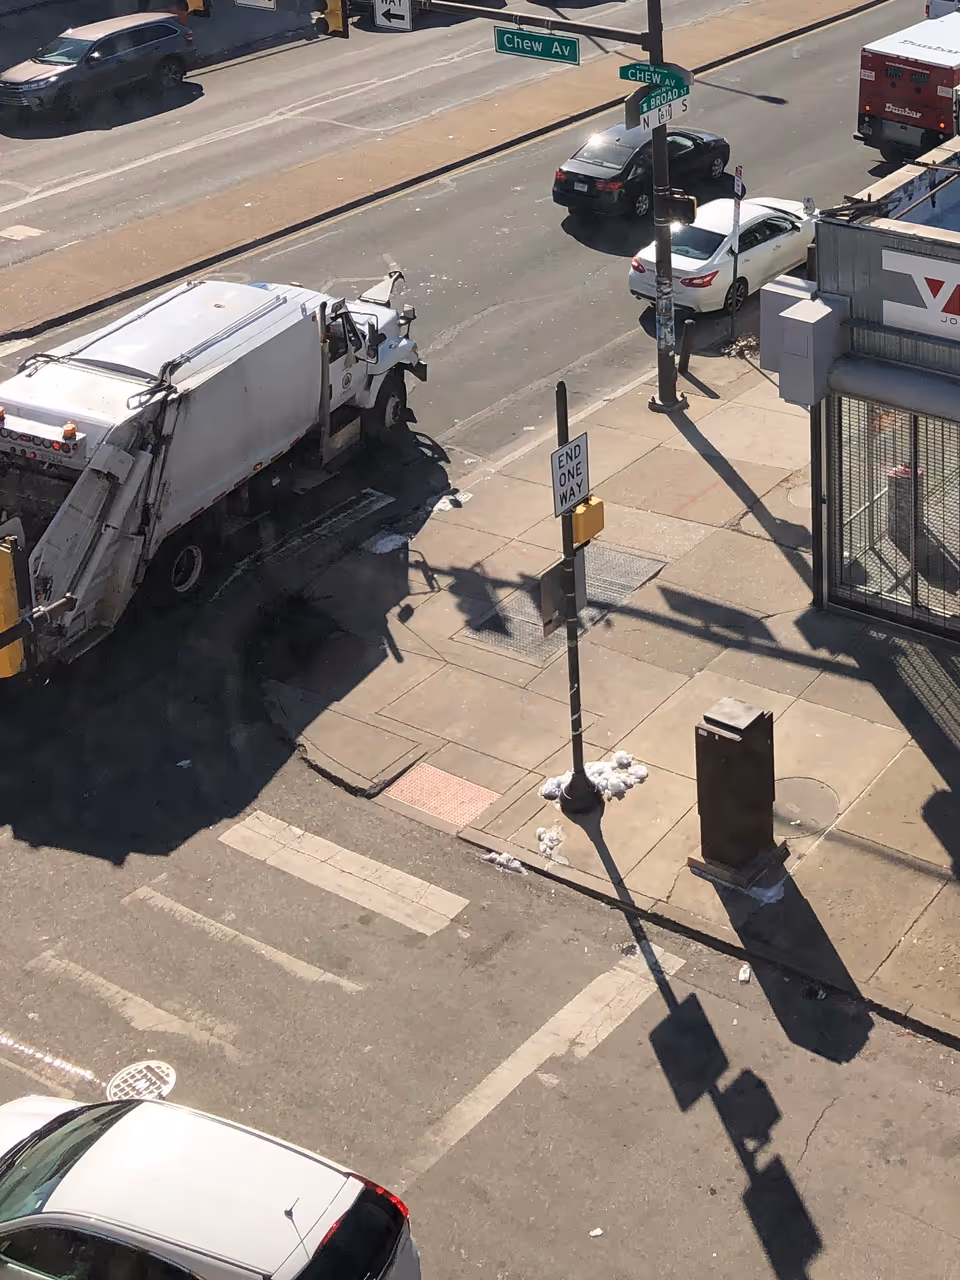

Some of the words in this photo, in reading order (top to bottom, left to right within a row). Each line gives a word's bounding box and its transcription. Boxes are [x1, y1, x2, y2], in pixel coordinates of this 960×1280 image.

[503, 34, 543, 52] Chew
[551, 41, 571, 56] Av
[628, 69, 661, 85] CHEW
[664, 78, 676, 87] AV
[650, 88, 679, 109] BROAD
[680, 87, 688, 96] ST
[642, 115, 650, 130] N
[681, 98, 688, 112] S
[885, 103, 922, 118] Dunbar
[557, 443, 582, 470] END
[559, 460, 583, 488] ONE
[559, 478, 584, 508] WAY
